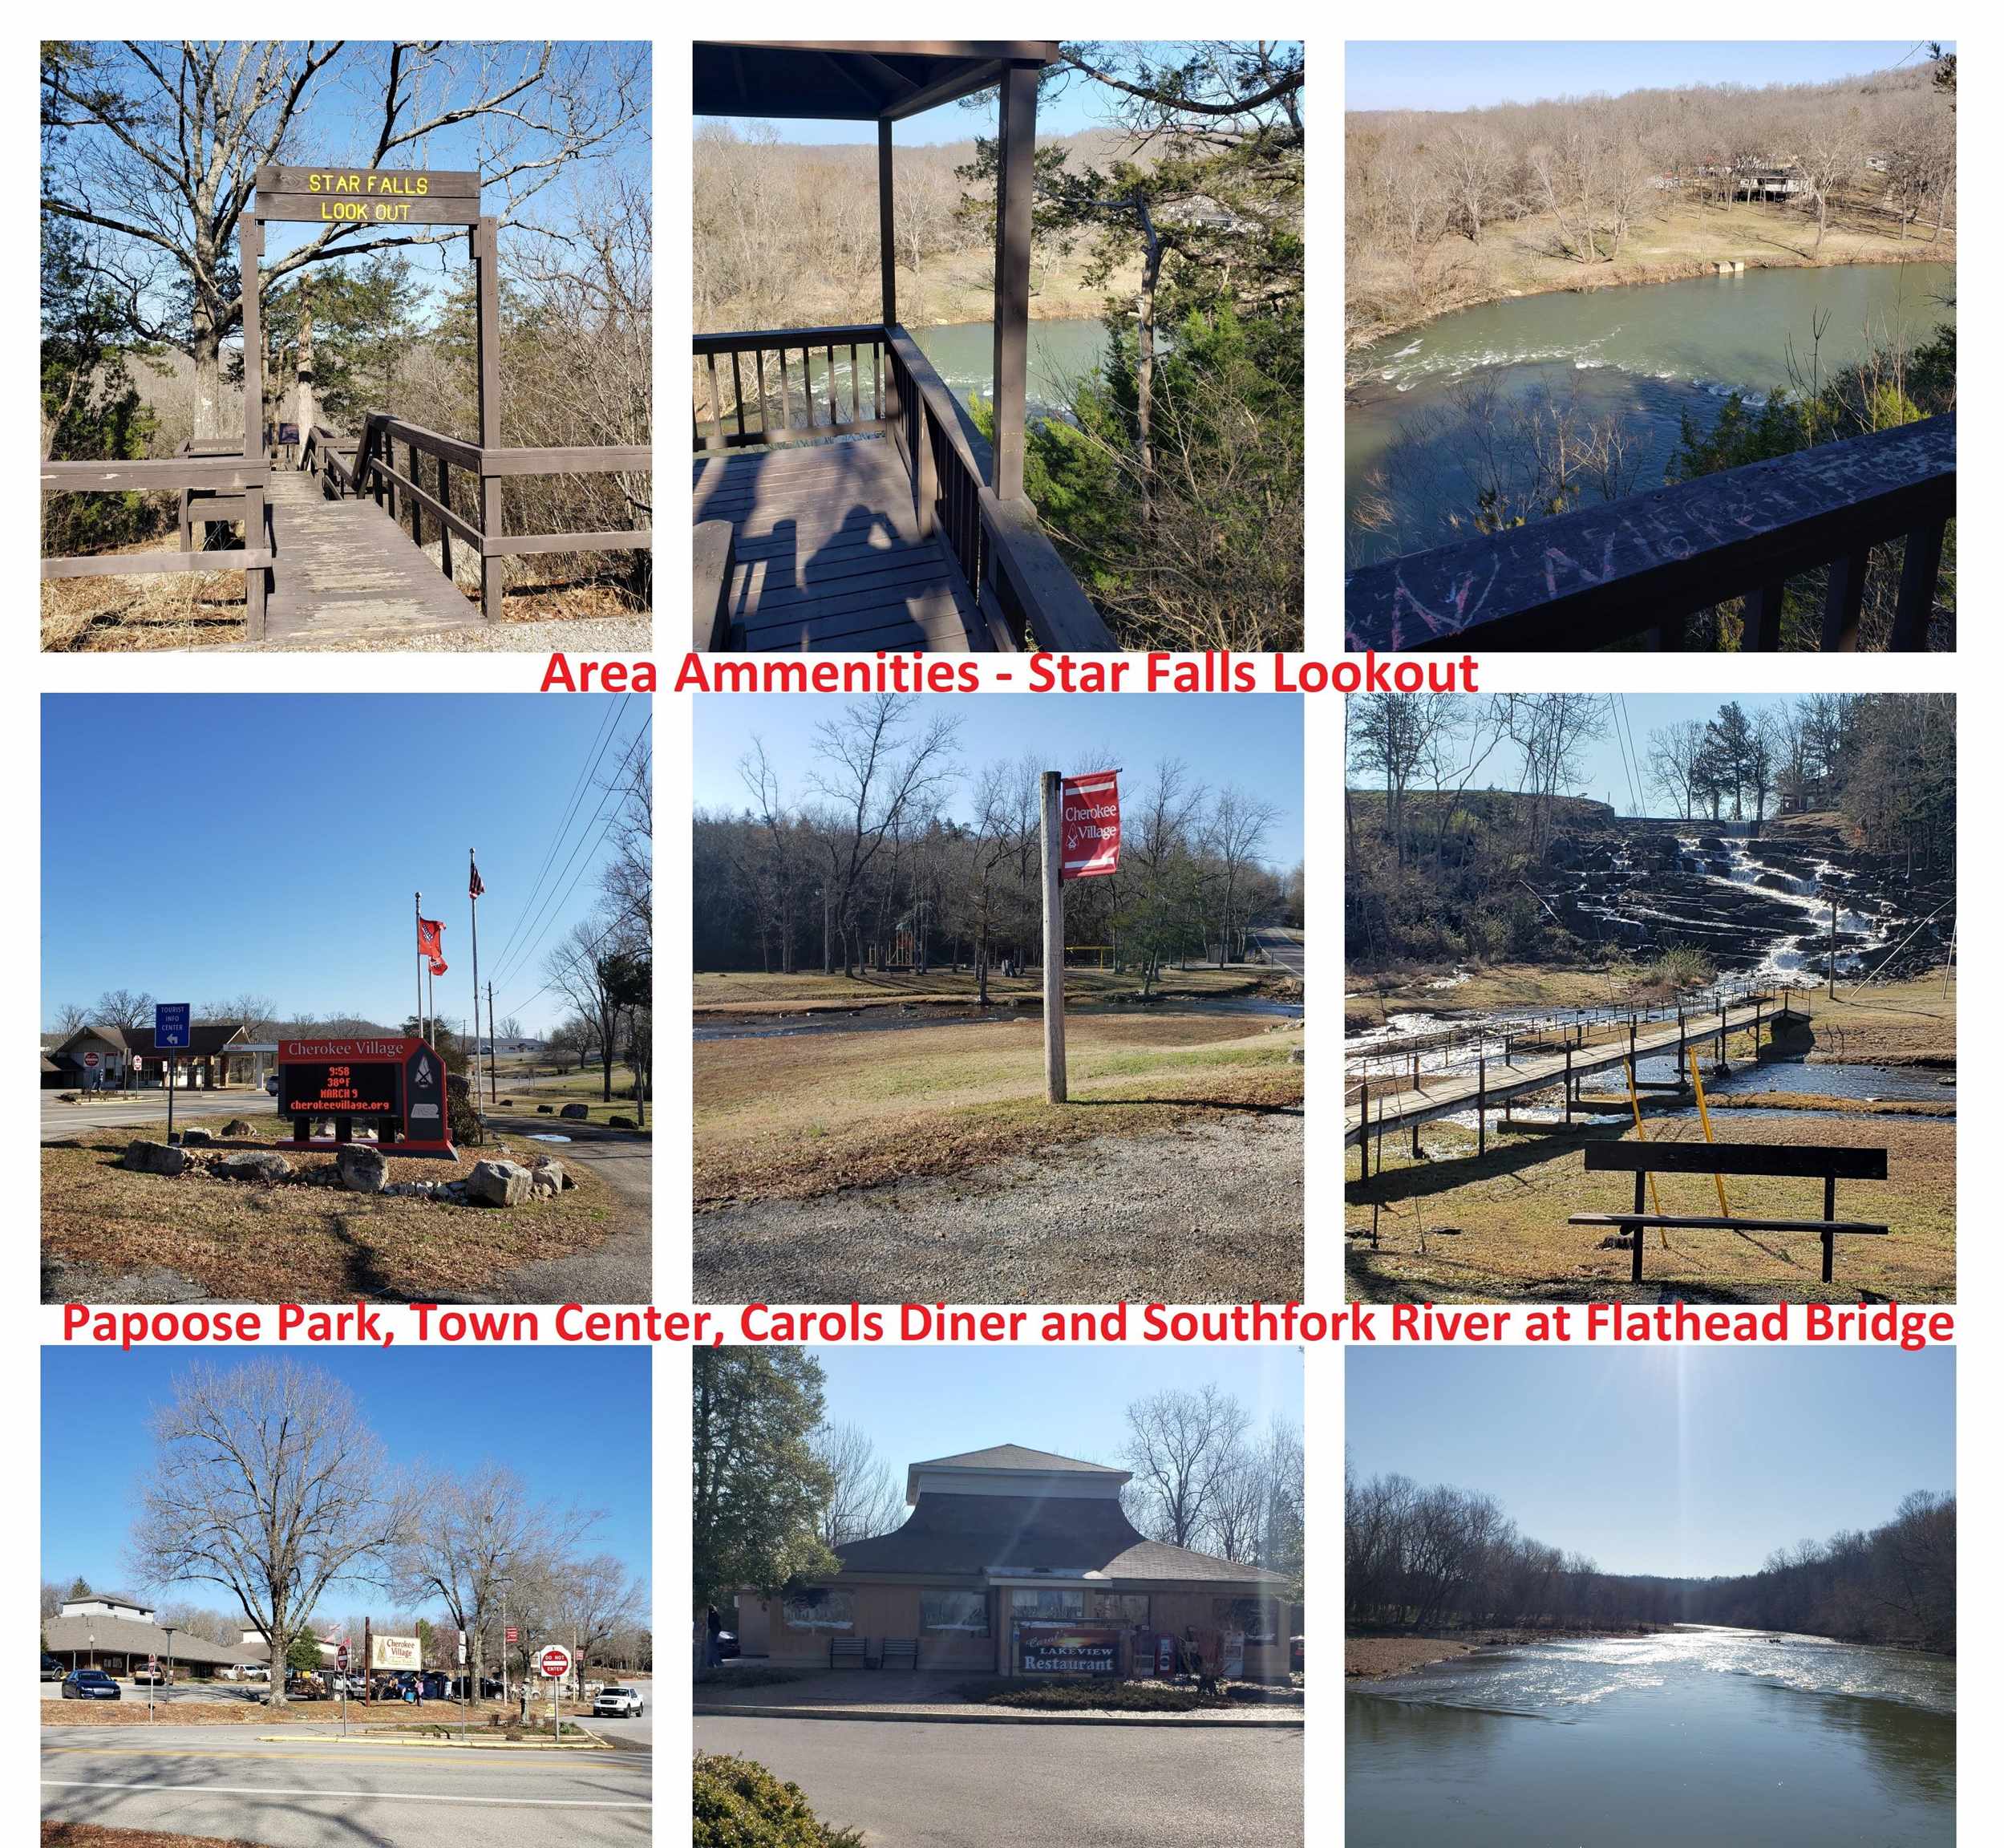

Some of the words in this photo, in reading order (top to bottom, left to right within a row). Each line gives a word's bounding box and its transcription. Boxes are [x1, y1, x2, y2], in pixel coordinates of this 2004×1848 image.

[309, 174, 360, 192] STAR
[367, 176, 428, 195] FALLS
[322, 202, 369, 220] LOOK
[375, 205, 411, 221] OUT
[1065, 804, 1116, 822] Cherokee
[1078, 825, 1116, 840] Village
[289, 1043, 351, 1056] Cherokee
[356, 1042, 403, 1057] Village
[329, 1066, 350, 1076] 9:58
[320, 1088, 349, 1098] MARCH
[351, 1088, 358, 1098] 9
[290, 1100, 390, 1110] cherokeevillage.org
[387, 1639, 415, 1648] Cherokee
[1026, 1629, 1067, 1648] Carol's
[391, 1647, 412, 1658] Village
[1025, 1656, 1113, 1670] Restaurant
